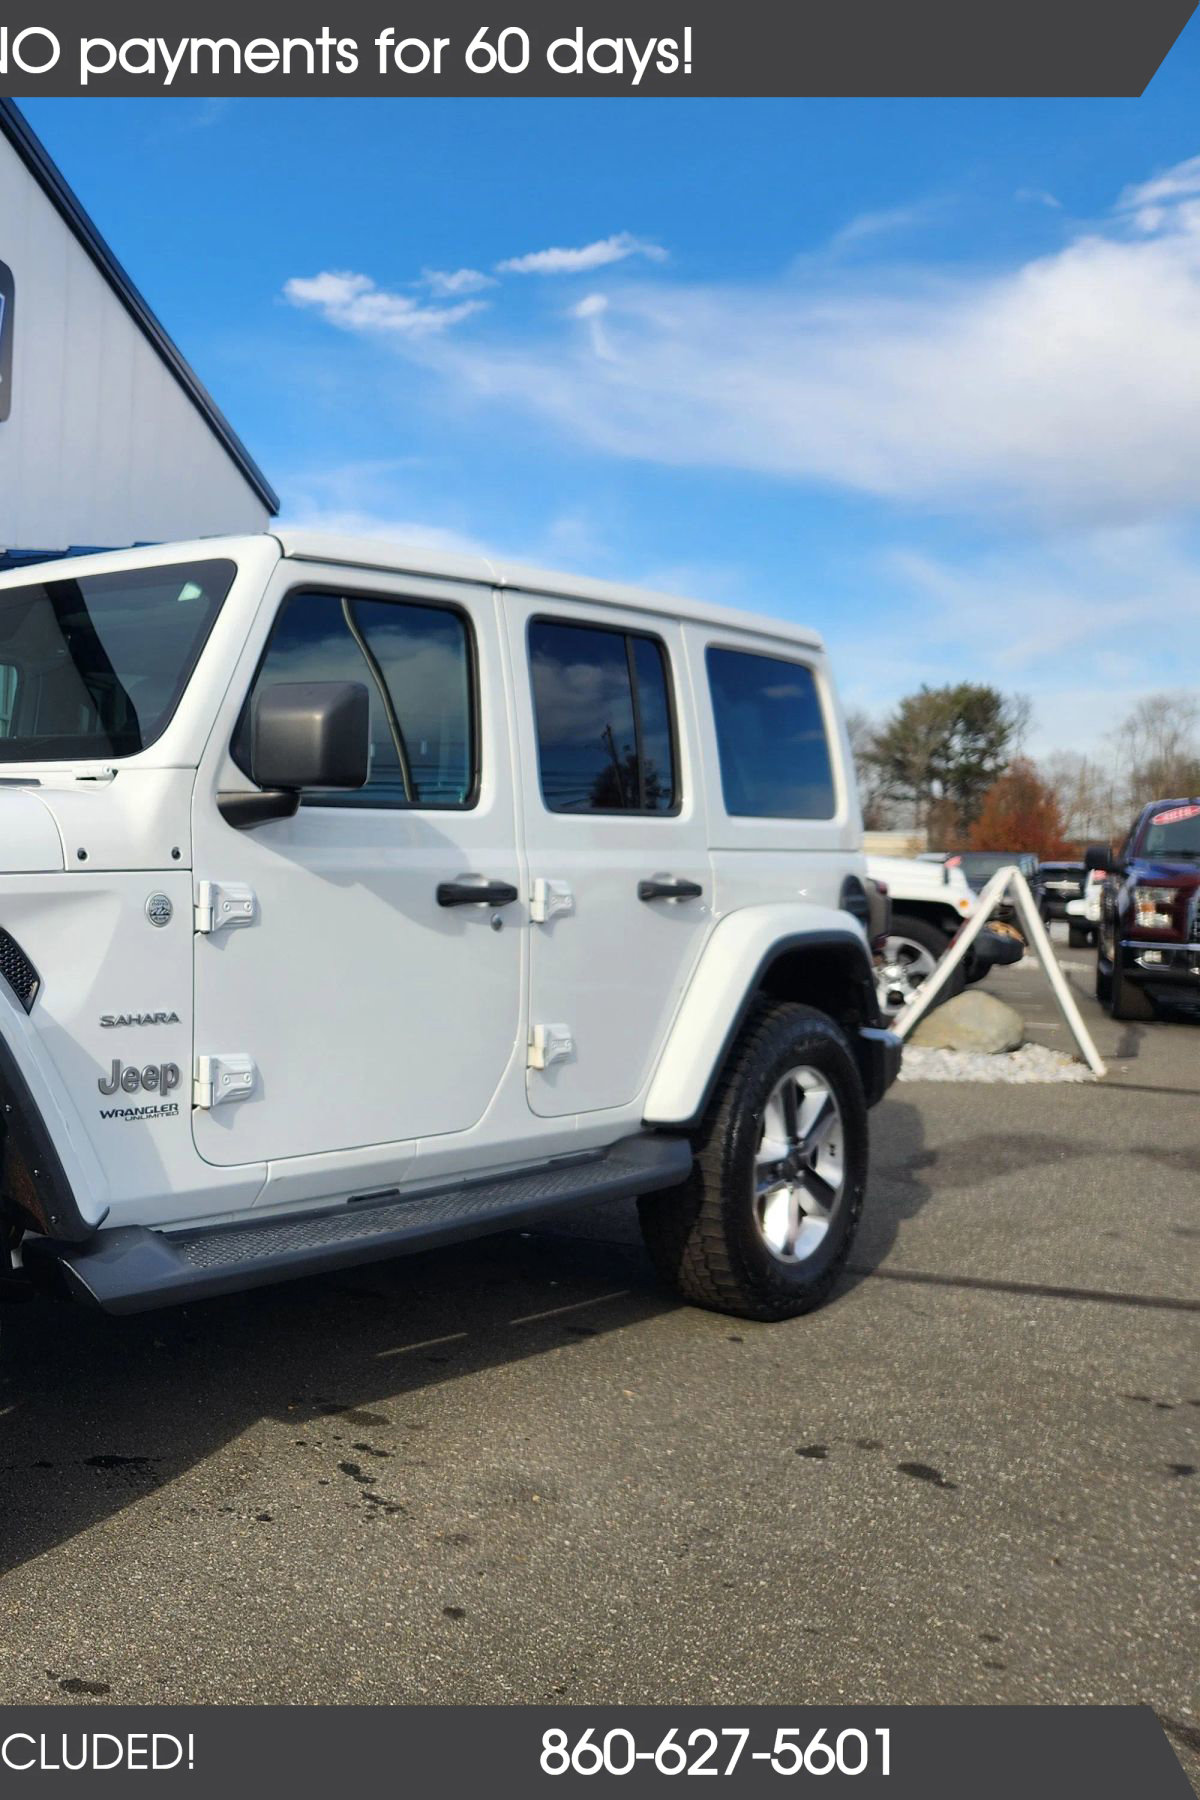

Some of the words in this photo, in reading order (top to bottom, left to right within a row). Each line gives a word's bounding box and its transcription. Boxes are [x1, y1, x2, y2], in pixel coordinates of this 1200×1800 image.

[99, 1011, 181, 1028] SAHARA
[97, 1058, 181, 1097] Jeep
[99, 1102, 179, 1119] WRANGLER
[124, 1110, 180, 1122] UNLIMITED
